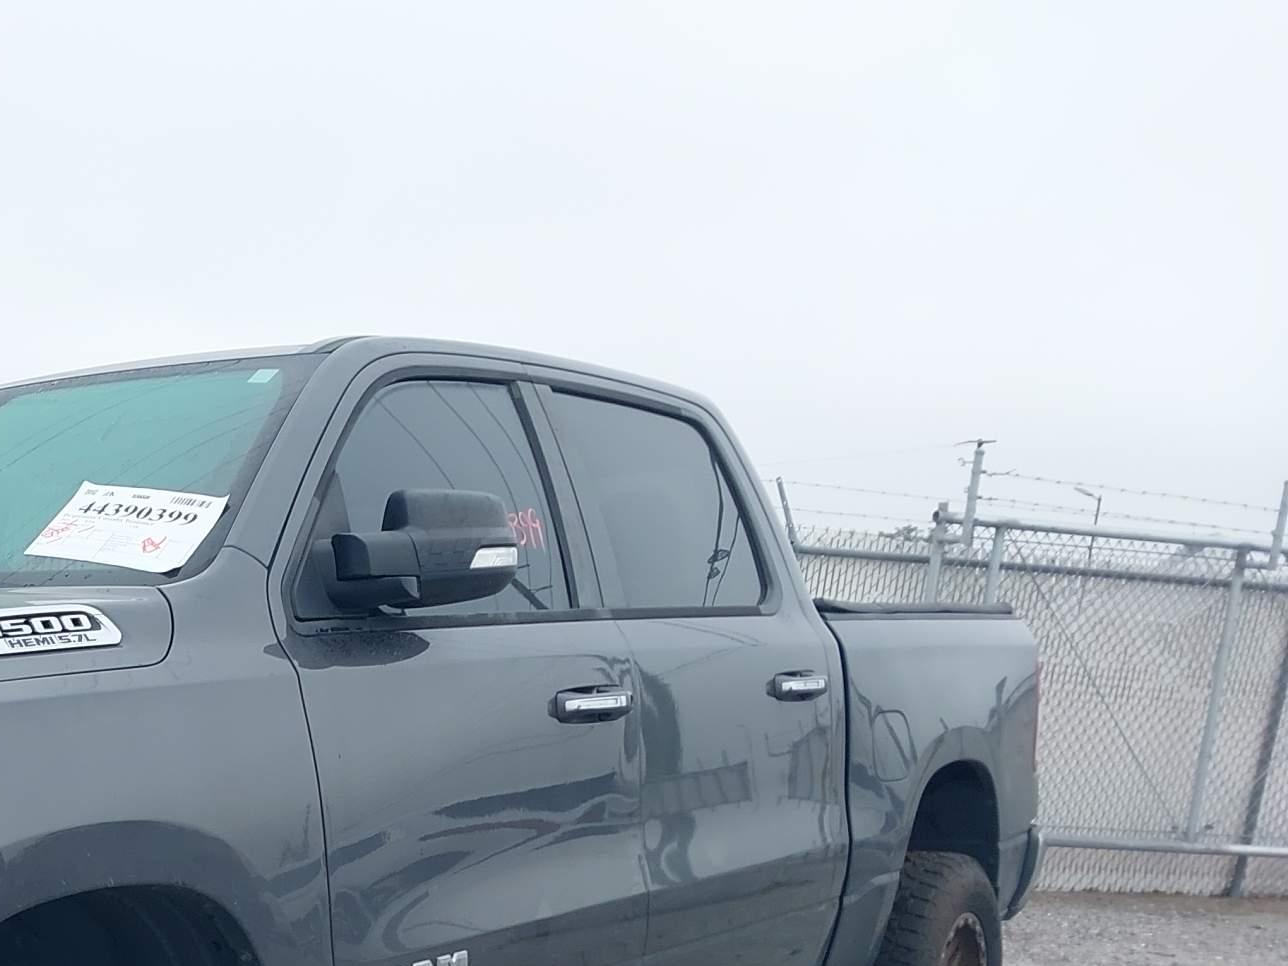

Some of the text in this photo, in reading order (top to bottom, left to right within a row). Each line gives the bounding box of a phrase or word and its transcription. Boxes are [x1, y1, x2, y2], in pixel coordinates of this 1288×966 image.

[78, 501, 198, 526] 44390399
[8, 632, 97, 649] HEMI 5.7L
